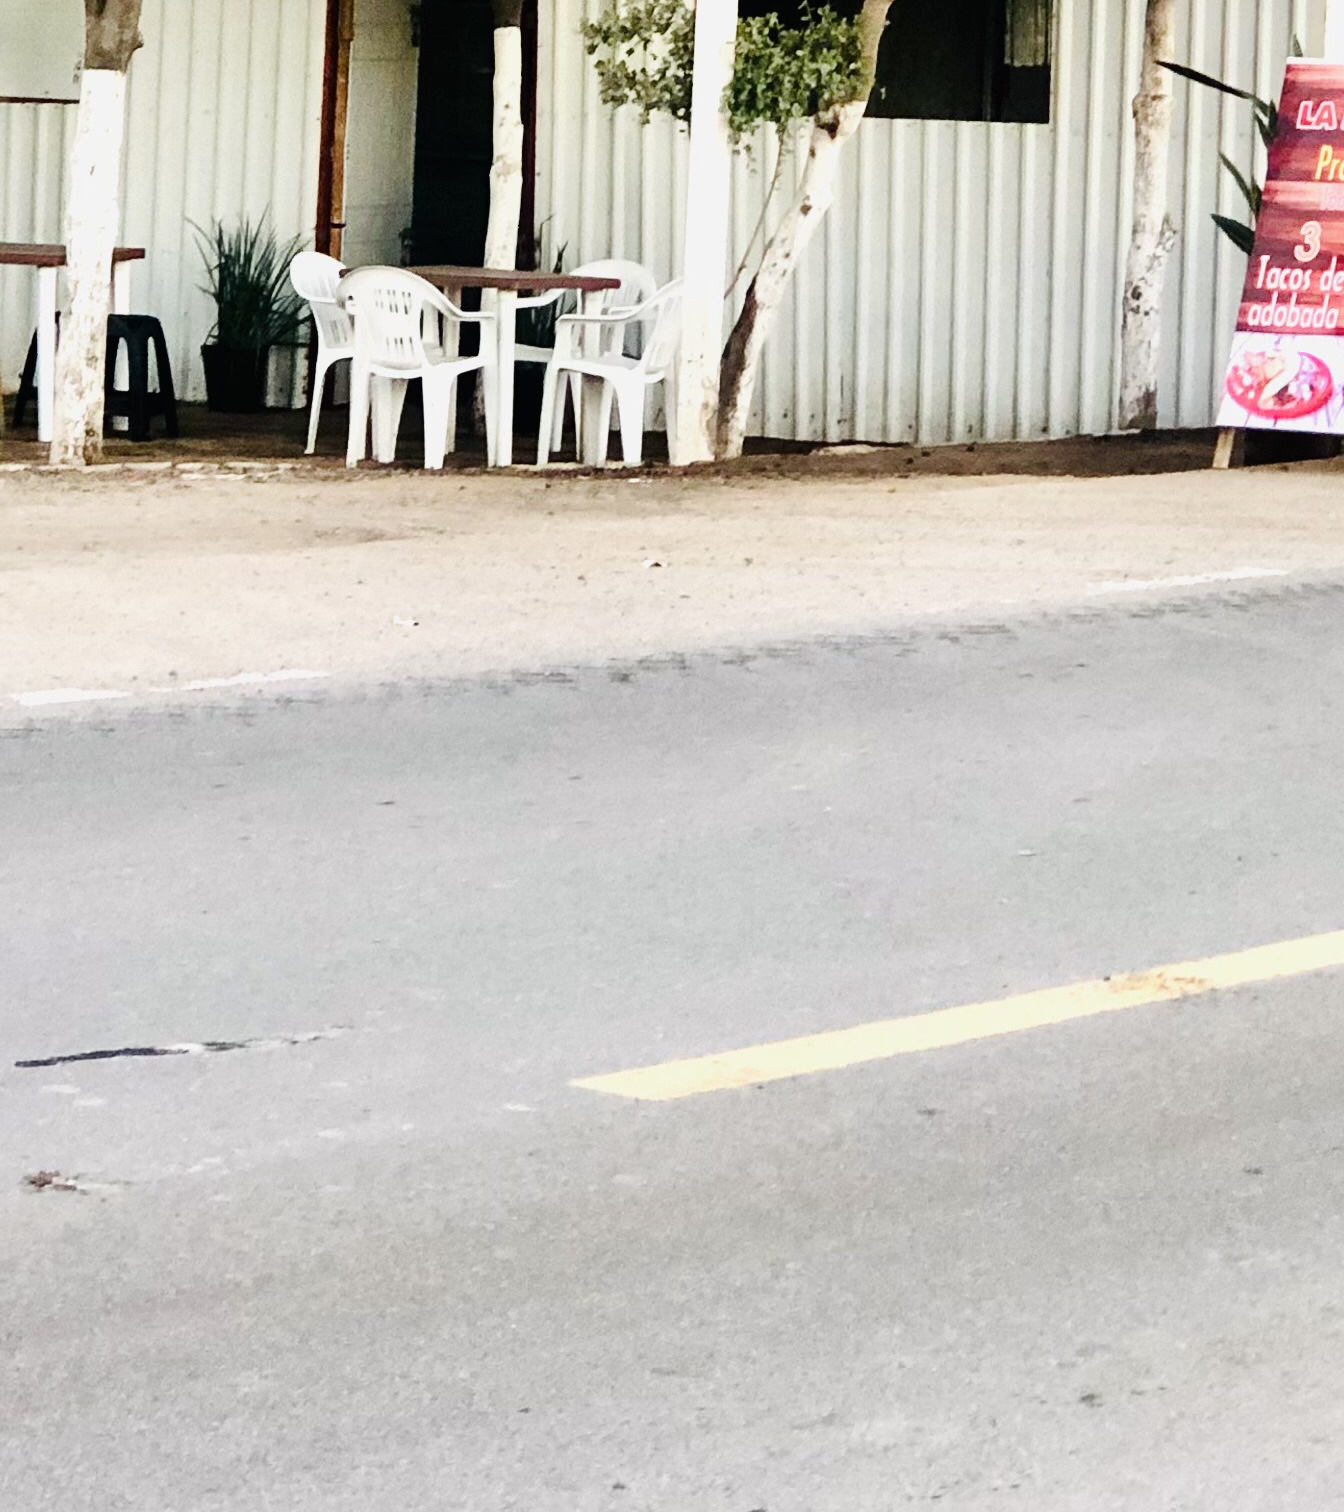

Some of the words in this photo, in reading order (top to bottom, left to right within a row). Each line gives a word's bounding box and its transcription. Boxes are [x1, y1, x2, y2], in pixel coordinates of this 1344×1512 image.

[1296, 100, 1338, 131] LA
[1294, 221, 1322, 261] 3
[1256, 255, 1311, 291] Tacos
[1247, 290, 1340, 329] adobada
